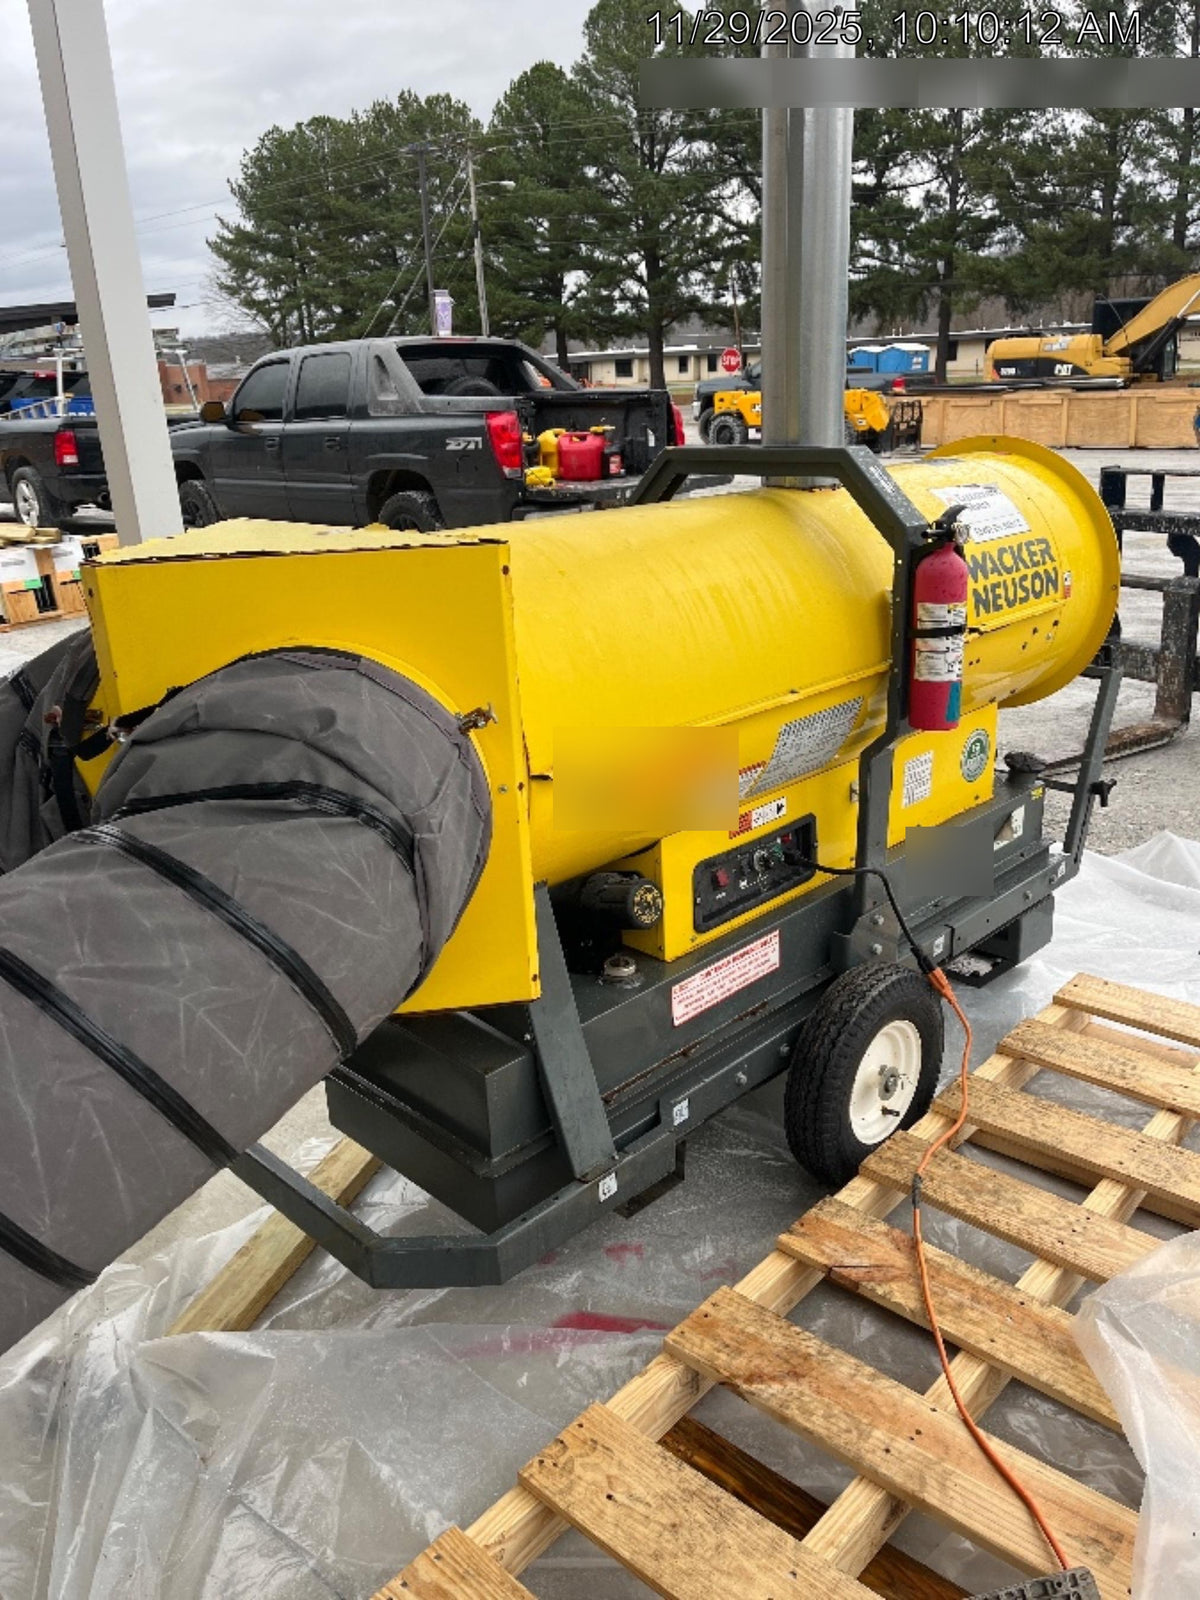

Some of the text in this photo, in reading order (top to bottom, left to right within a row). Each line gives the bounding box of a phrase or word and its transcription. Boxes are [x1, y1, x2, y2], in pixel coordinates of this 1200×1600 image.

[722, 355, 740, 366] STOP
[1054, 364, 1073, 376] CAT
[445, 437, 482, 450] Z71
[967, 537, 1057, 584] WACKER
[972, 566, 1059, 618] NEUSON
